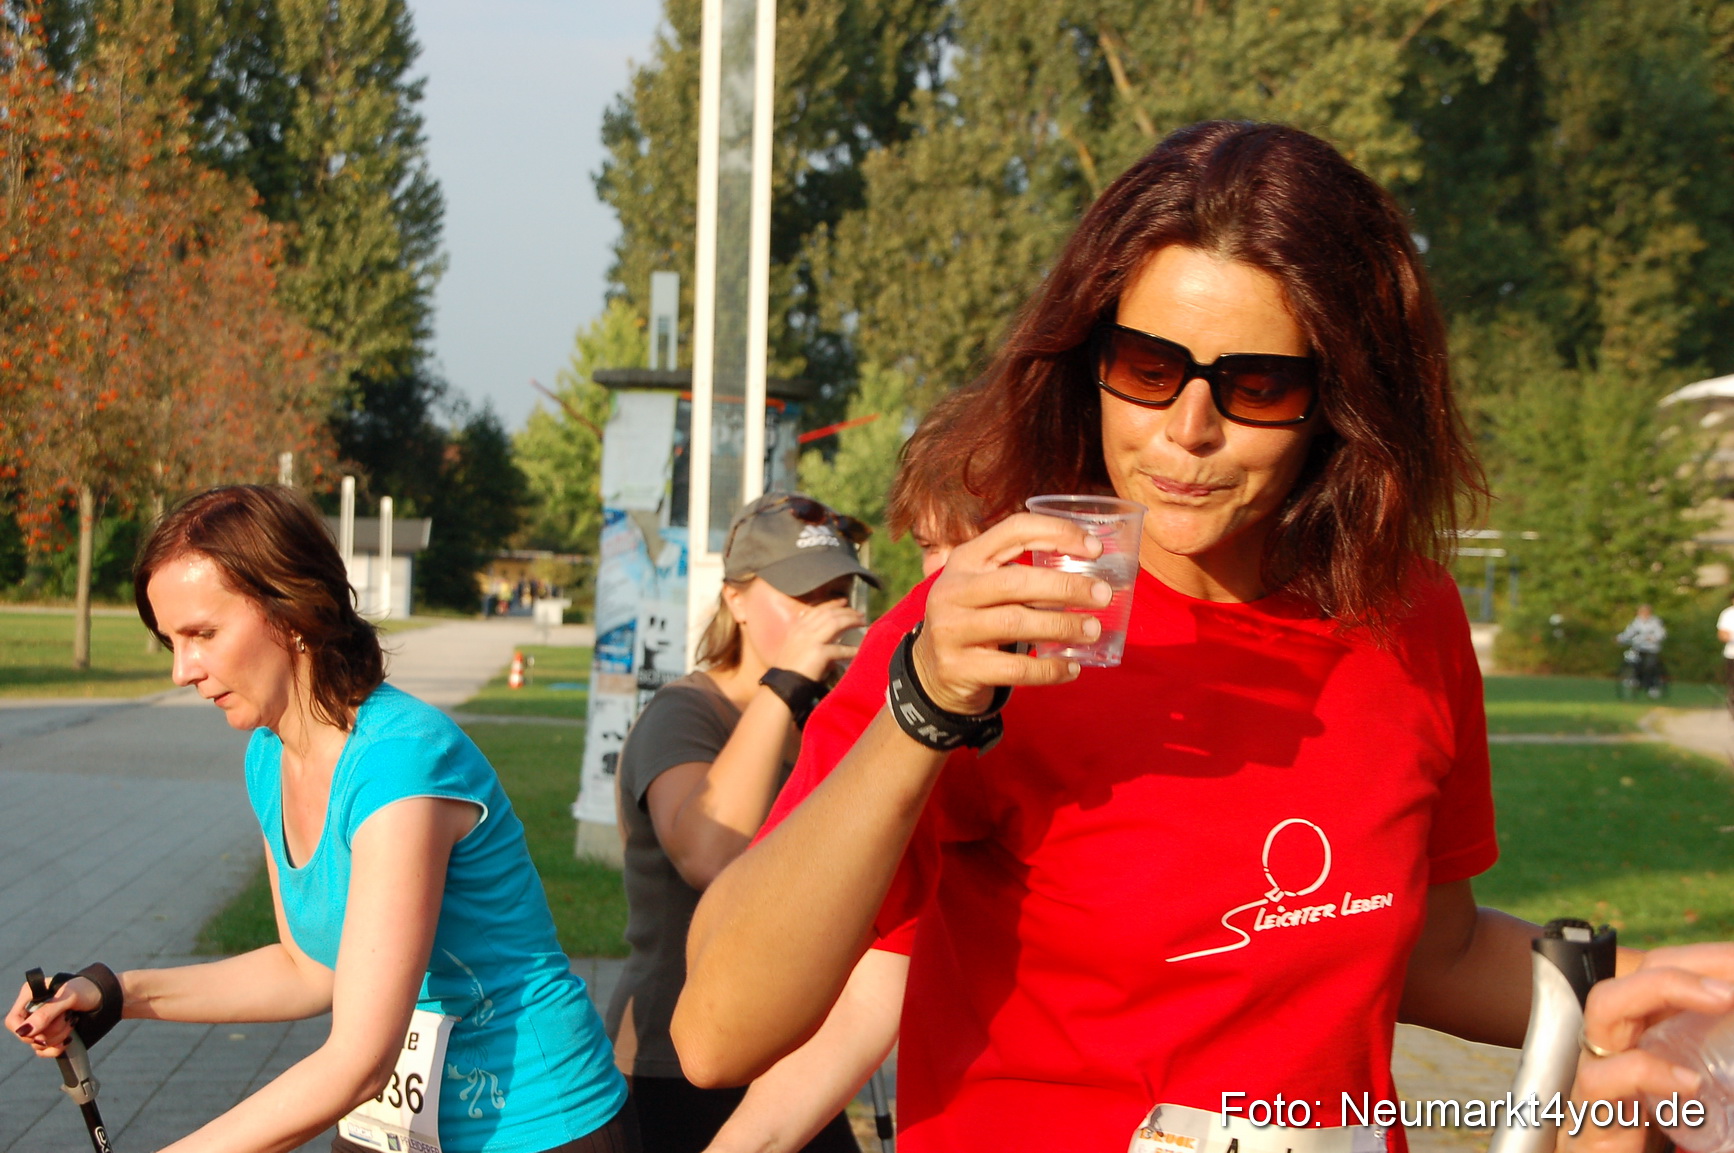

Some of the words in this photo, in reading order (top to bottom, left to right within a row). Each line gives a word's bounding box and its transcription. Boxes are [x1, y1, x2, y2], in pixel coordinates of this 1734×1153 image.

[1253, 903, 1337, 932] LEICHTER
[1340, 891, 1394, 916] LEBEN
[375, 1070, 424, 1115] 36
